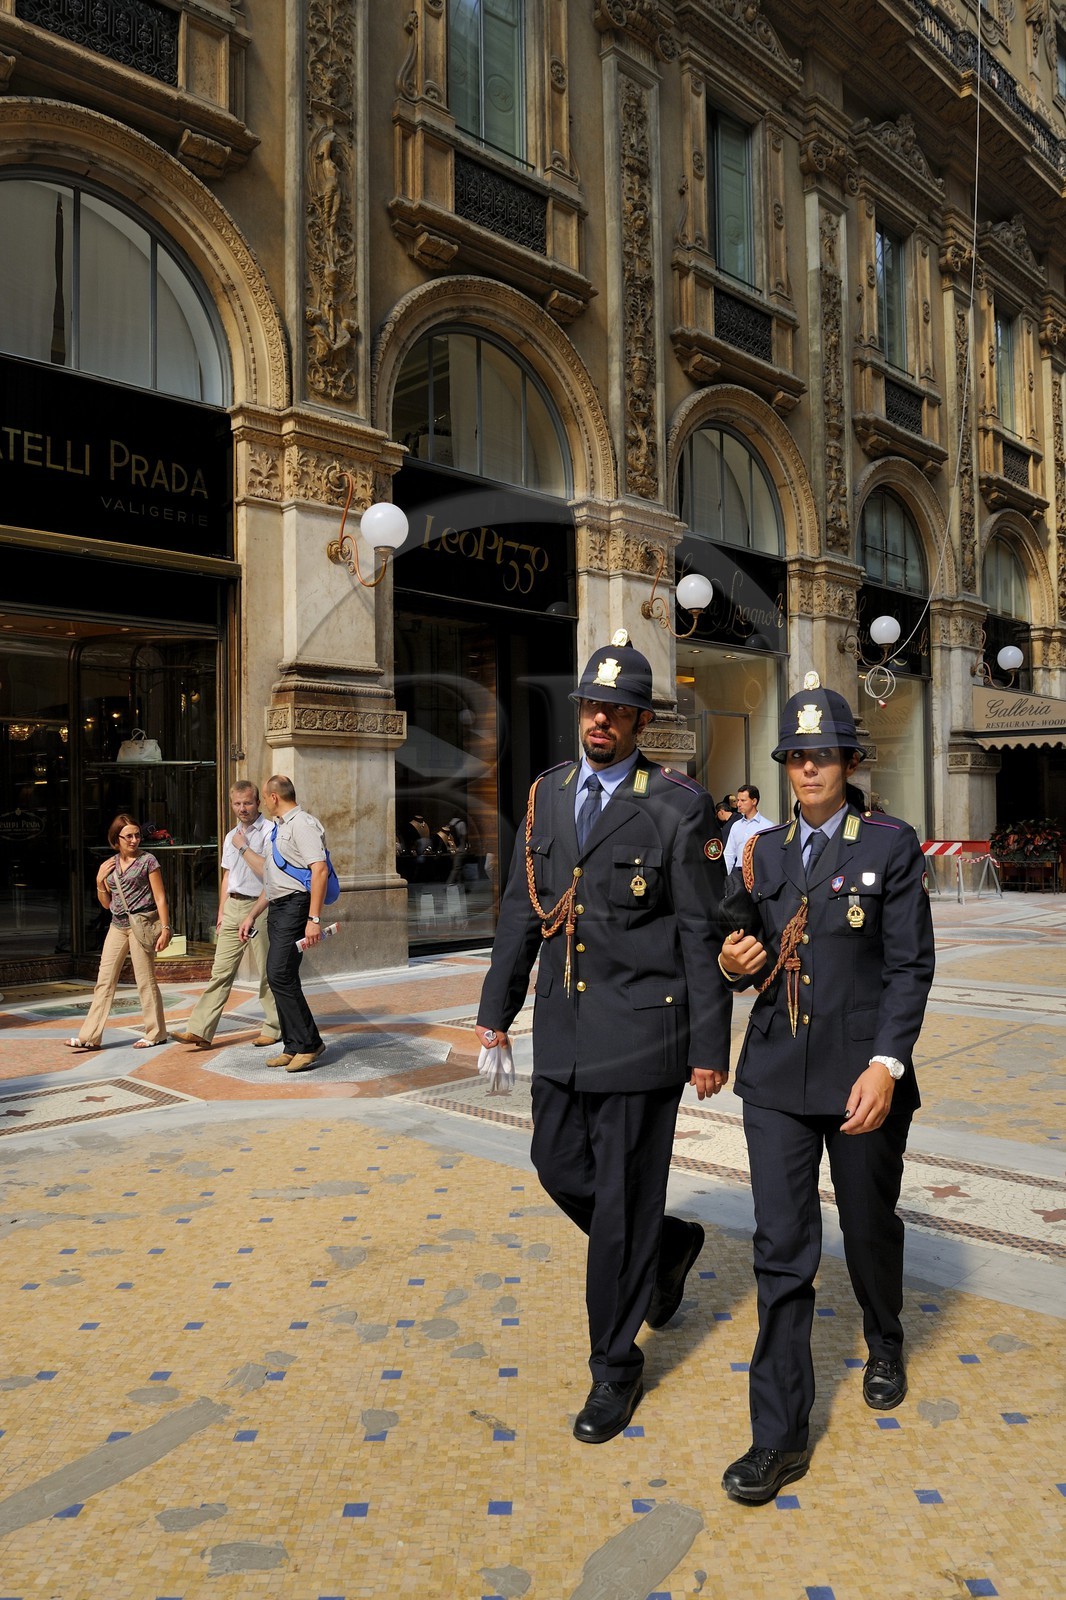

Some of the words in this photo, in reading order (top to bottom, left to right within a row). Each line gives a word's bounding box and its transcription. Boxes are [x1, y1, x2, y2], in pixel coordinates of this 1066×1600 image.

[109, 439, 209, 499] PRADA
[100, 496, 209, 527] VALIGERIE
[984, 697, 1052, 719] Galleria
[985, 720, 1035, 729] RESTAURANT
